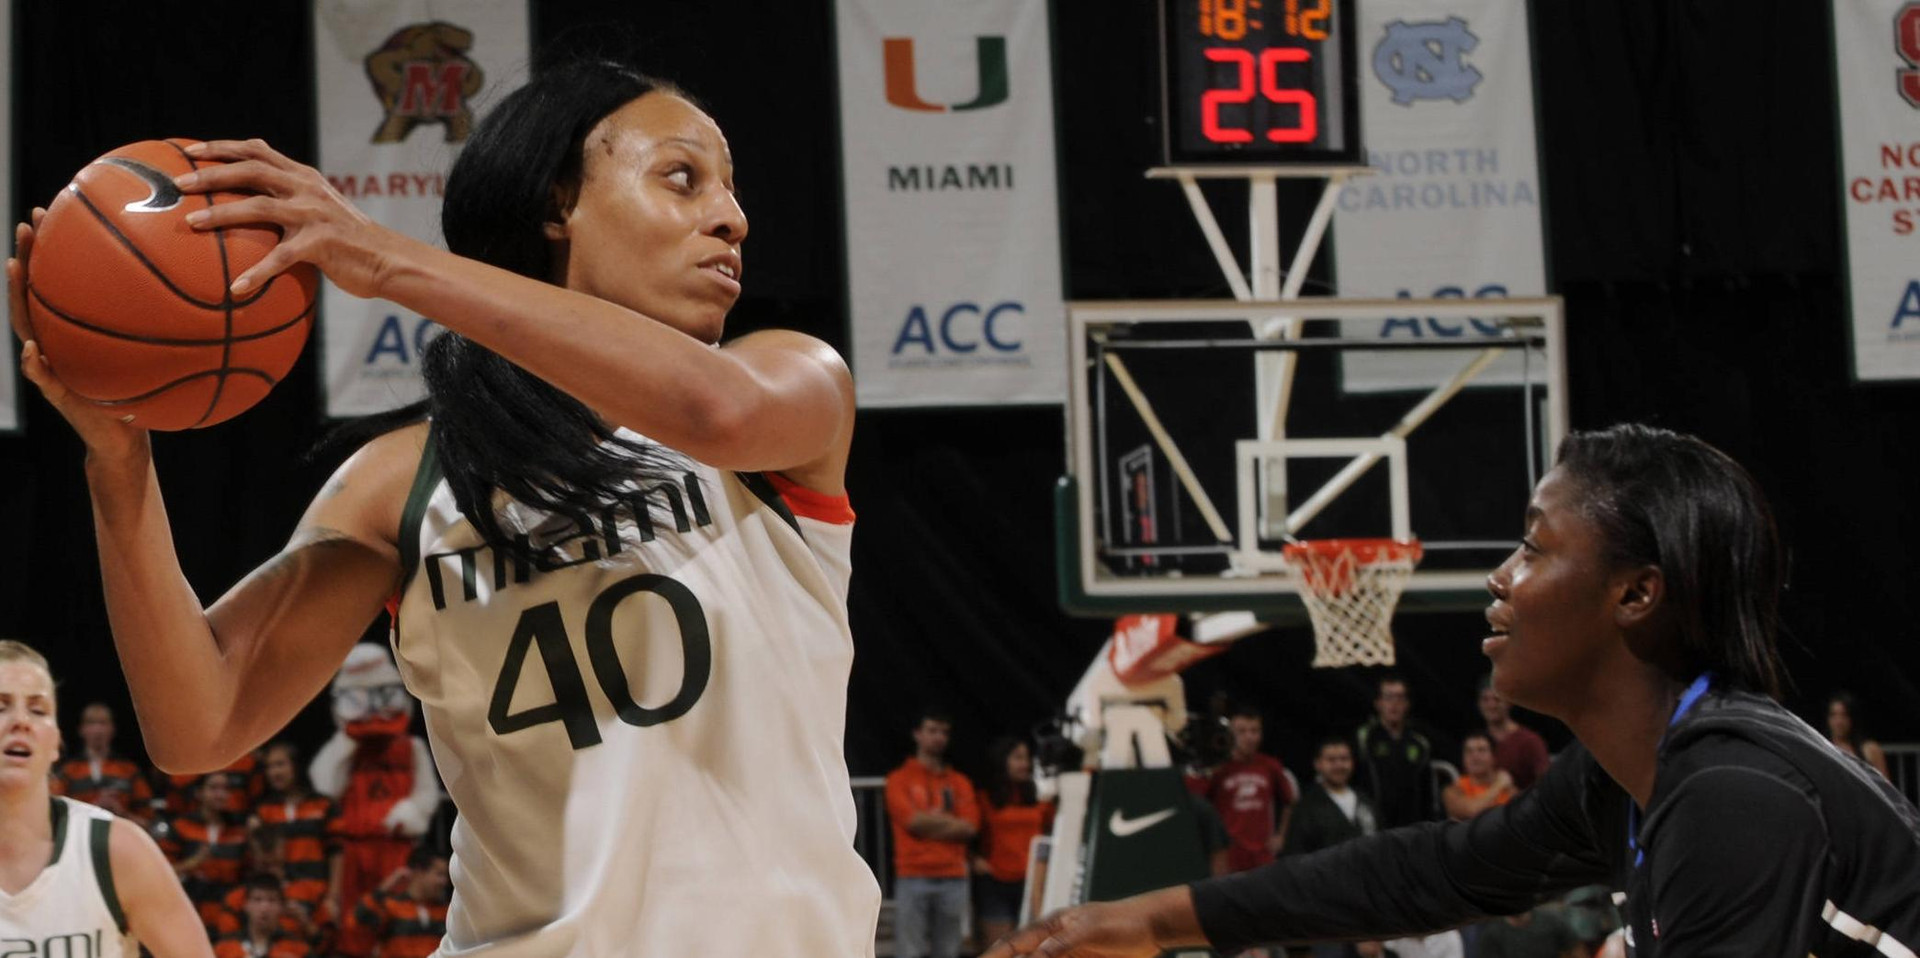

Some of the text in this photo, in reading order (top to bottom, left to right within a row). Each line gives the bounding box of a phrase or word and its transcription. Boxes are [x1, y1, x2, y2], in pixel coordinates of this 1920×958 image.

[402, 62, 467, 114] M
[1201, 47, 1317, 143] 25
[888, 164, 1014, 191] MIAMI
[1369, 148, 1500, 176] NORTH
[1338, 180, 1534, 212] CAROLINA
[1893, 210, 1920, 235] S
[892, 302, 1025, 354] ACC
[488, 573, 711, 750] 40
